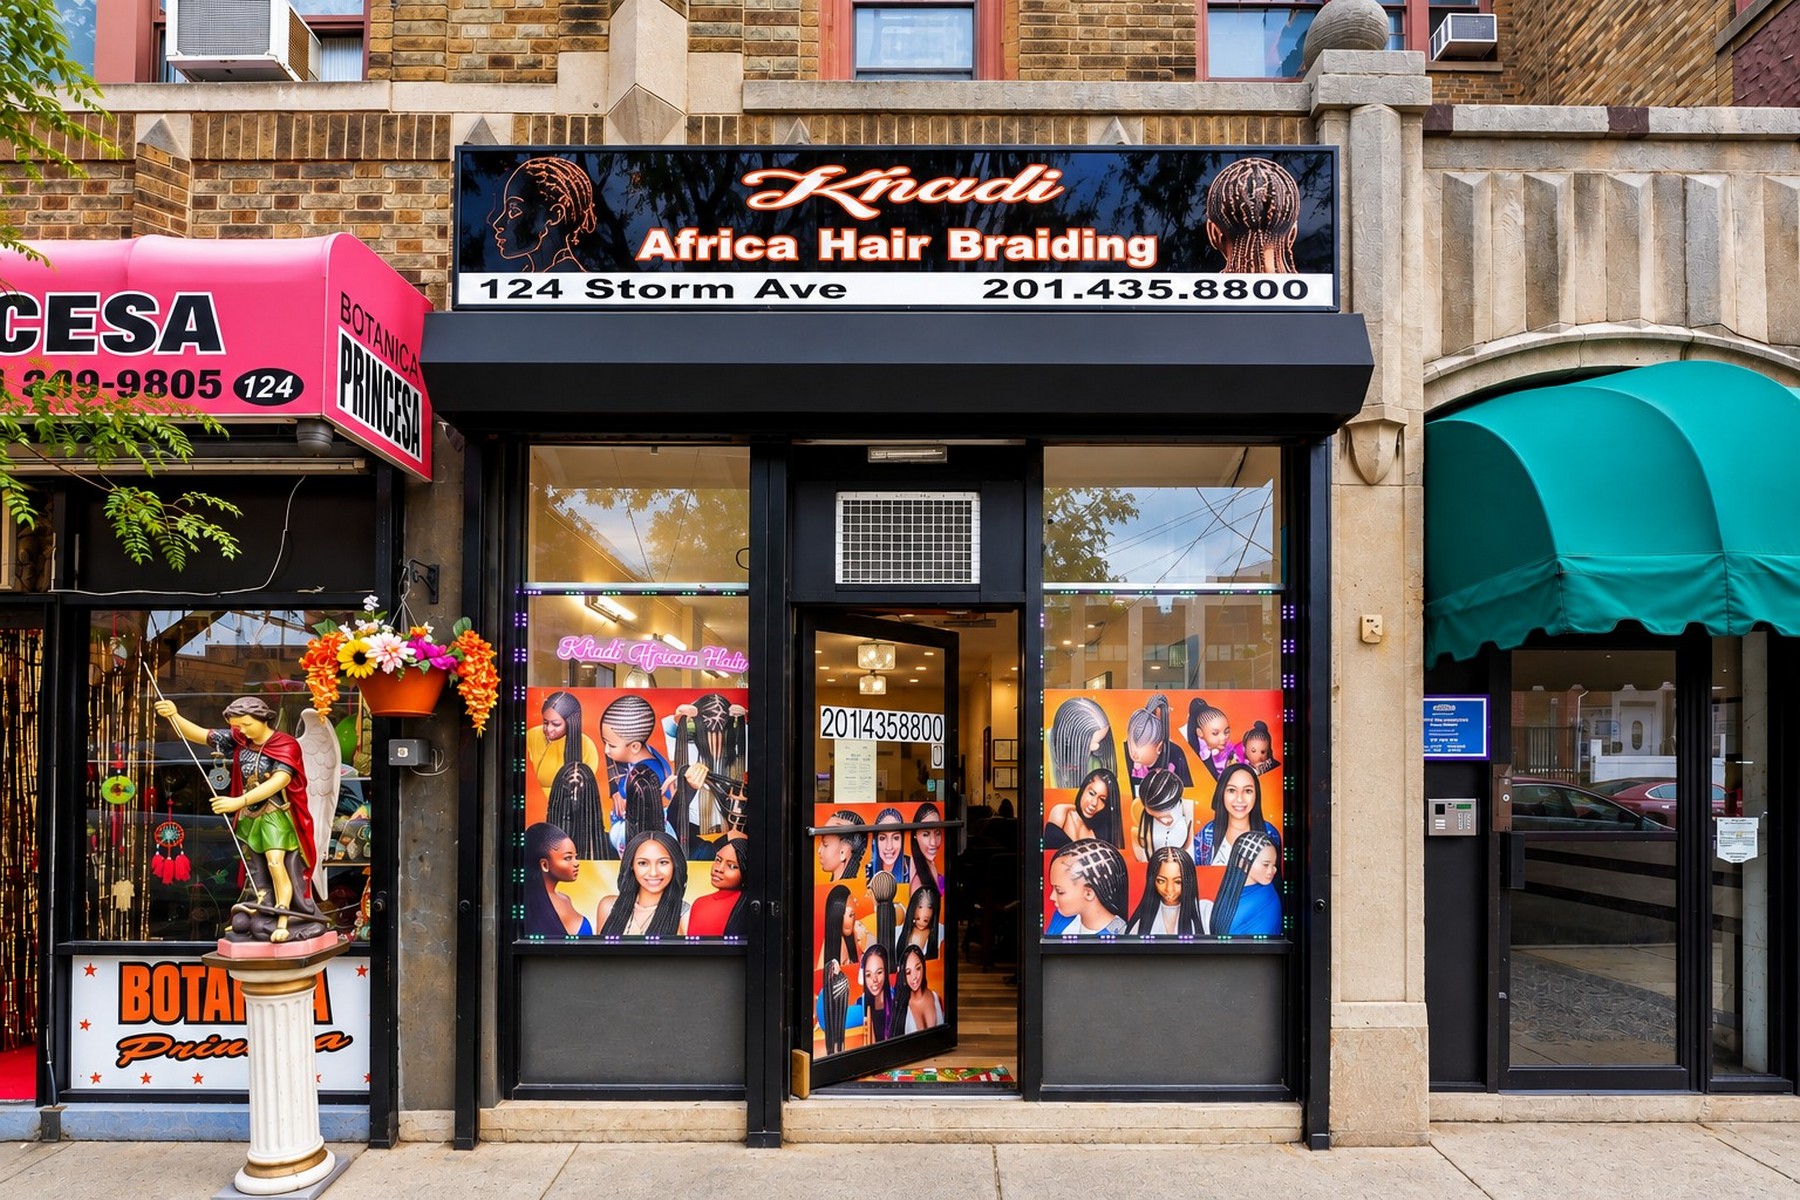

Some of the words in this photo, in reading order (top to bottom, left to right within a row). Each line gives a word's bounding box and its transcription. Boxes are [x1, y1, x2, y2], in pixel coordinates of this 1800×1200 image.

[635, 227, 799, 262] Africa
[818, 227, 932, 262] Hair
[947, 227, 1158, 269] Braiding
[480, 278, 563, 299] 124
[585, 278, 733, 299] Storm
[754, 278, 848, 299] Ave
[982, 278, 1309, 300] 201.435.8800
[340, 291, 420, 384] BOTANICA
[243, 375, 294, 399] 124
[340, 333, 420, 458] PRINCESA
[118, 961, 333, 1025] BOTAA
[115, 1030, 353, 1068] Prina
